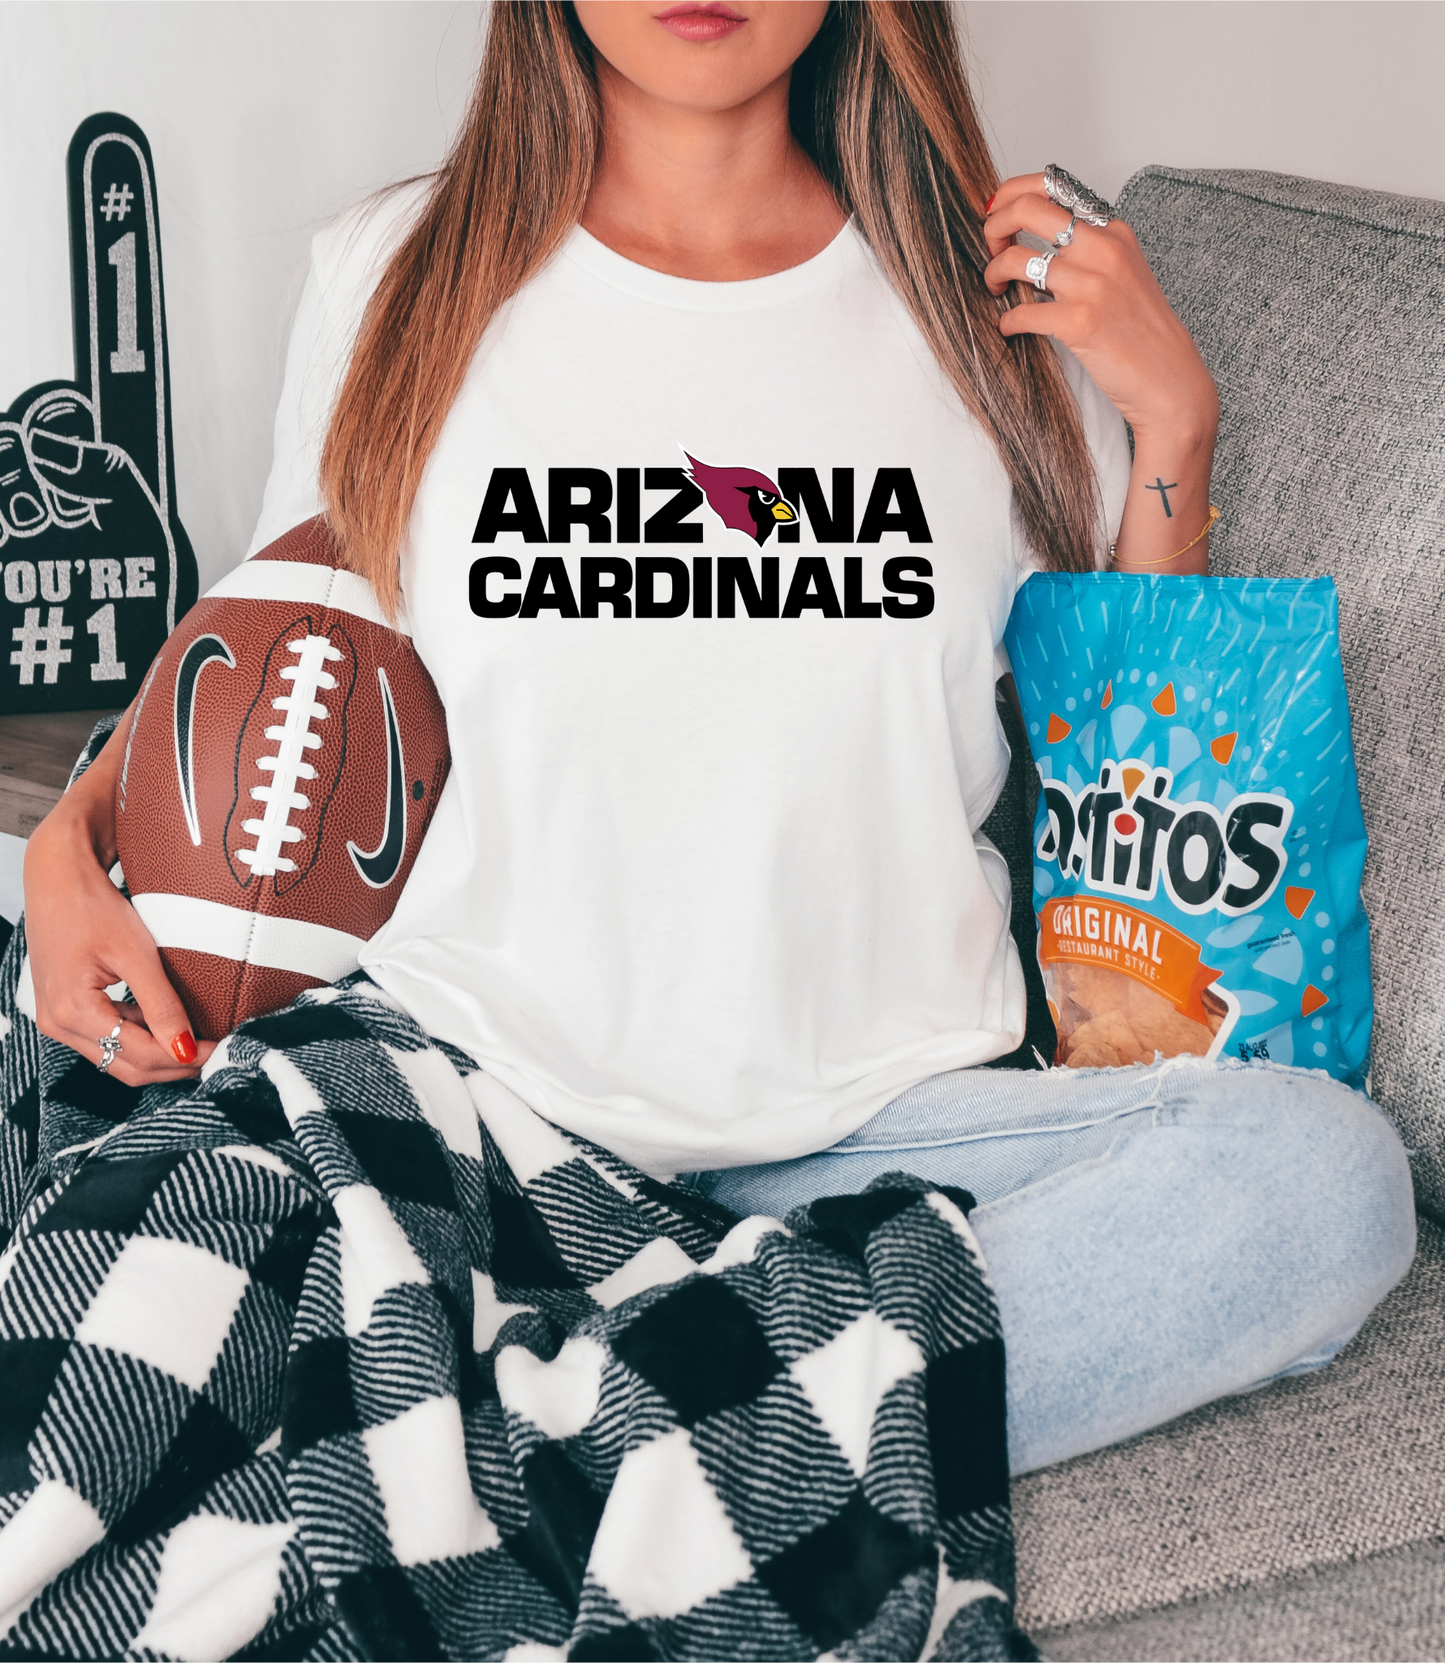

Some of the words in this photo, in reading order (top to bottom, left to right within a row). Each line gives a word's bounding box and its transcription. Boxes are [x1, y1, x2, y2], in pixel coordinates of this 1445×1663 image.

[100, 182, 134, 222] #
[108, 231, 146, 373] 1
[471, 467, 934, 544] ARIZNA
[0, 556, 156, 603] OU'RE
[468, 556, 935, 619] CARDINALS
[10, 603, 126, 685] #1
[1053, 904, 1162, 965] ORIGINAL
[1058, 939, 1119, 962] RESTAURANT
[1124, 953, 1157, 980] STYLE
